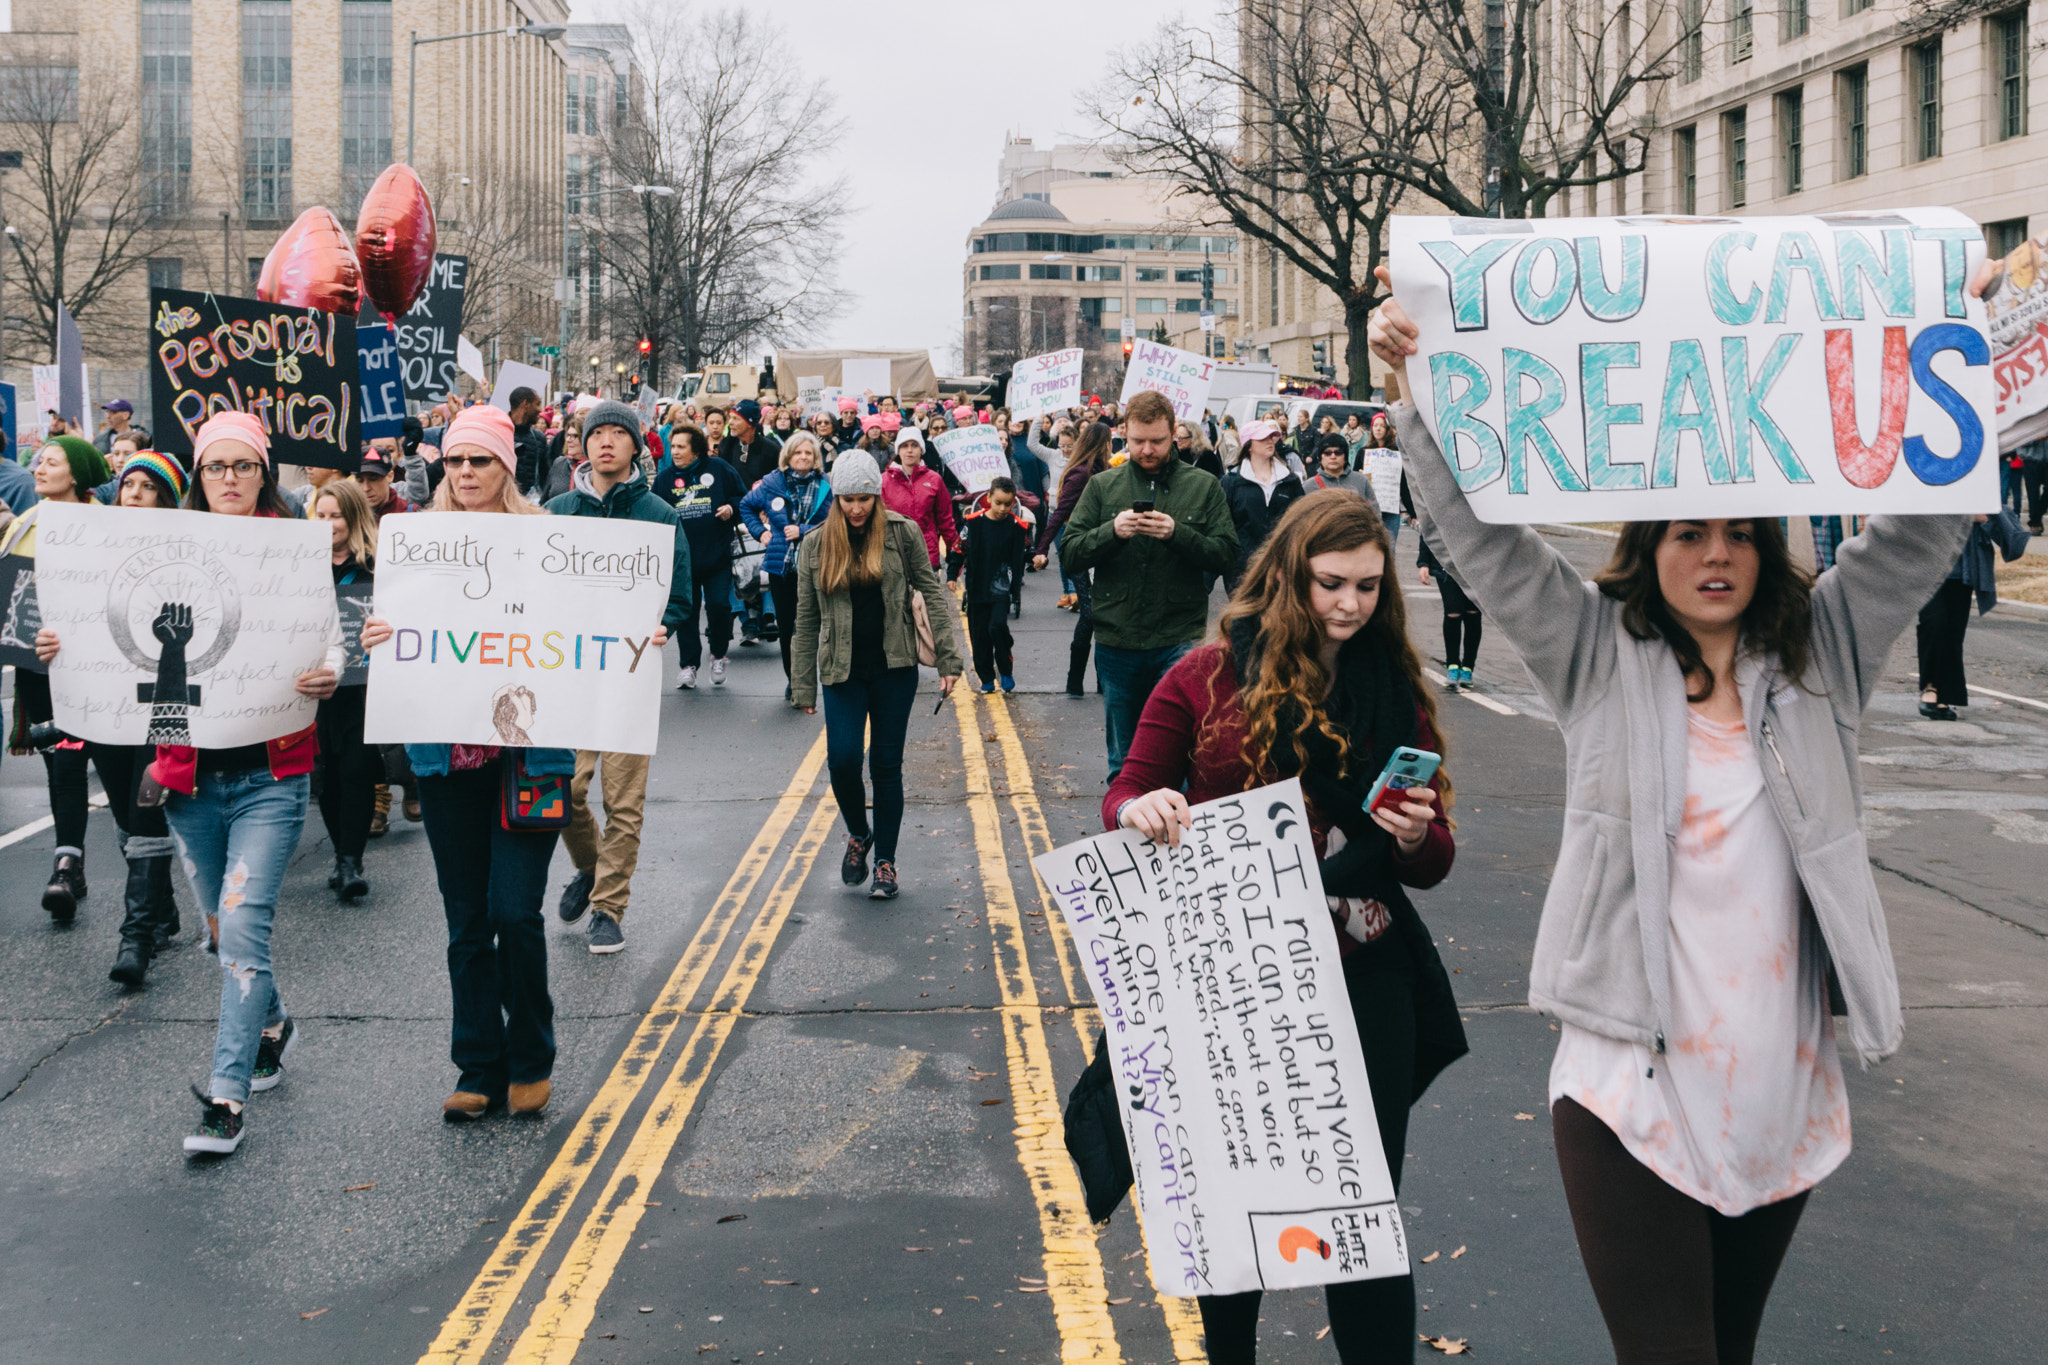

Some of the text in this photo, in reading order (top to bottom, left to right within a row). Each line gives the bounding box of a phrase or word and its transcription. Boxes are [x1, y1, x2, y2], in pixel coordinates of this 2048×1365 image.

[425, 259, 465, 290] ME
[1419, 235, 1647, 332] YOU
[155, 301, 201, 337] the
[159, 312, 336, 391] Personal
[275, 348, 302, 384] is
[1036, 350, 1081, 371] SEXIST
[1138, 343, 1178, 368] WHY
[1180, 364, 1198, 377] DO
[1031, 373, 1079, 396] FEMINIST
[1146, 366, 1183, 386] STILL
[1175, 388, 1188, 400] TO
[1428, 323, 1990, 496] BREAK US
[949, 455, 1003, 476] TRONGER
[387, 532, 493, 599] Beauty
[541, 533, 665, 591] Strength
[504, 603, 524, 614] IN
[396, 628, 650, 673] DIVERSITY
[1180, 844, 1199, 885] an
[1056, 879, 1094, 923] girl
[1189, 893, 1205, 930] be
[1164, 913, 1184, 990] back.
[1284, 917, 1319, 1003] raise
[1075, 852, 1146, 1026] everything
[1139, 1041, 1165, 1119] Why
[1166, 843, 1198, 944] ucceed
[1188, 953, 1207, 1023] when
[1204, 1032, 1224, 1083] half
[1226, 1139, 1239, 1170] are
[1192, 812, 1285, 1171] that those without a voice
[1219, 799, 1324, 1185] not so I can shout but so
[1296, 1012, 1334, 1052] up
[1093, 840, 1148, 924] If
[1154, 1025, 1182, 1114] man
[1177, 1124, 1198, 1196] can
[1192, 1203, 1213, 1289] destroy
[1221, 1045, 1237, 1079] we
[1315, 1059, 1347, 1110] my
[1231, 1089, 1258, 1169] cannot
[1329, 1116, 1362, 1199] voice
[1344, 1213, 1369, 1269] HATE
[1363, 1211, 1380, 1229] I
[1331, 1217, 1353, 1274] CHEESE
